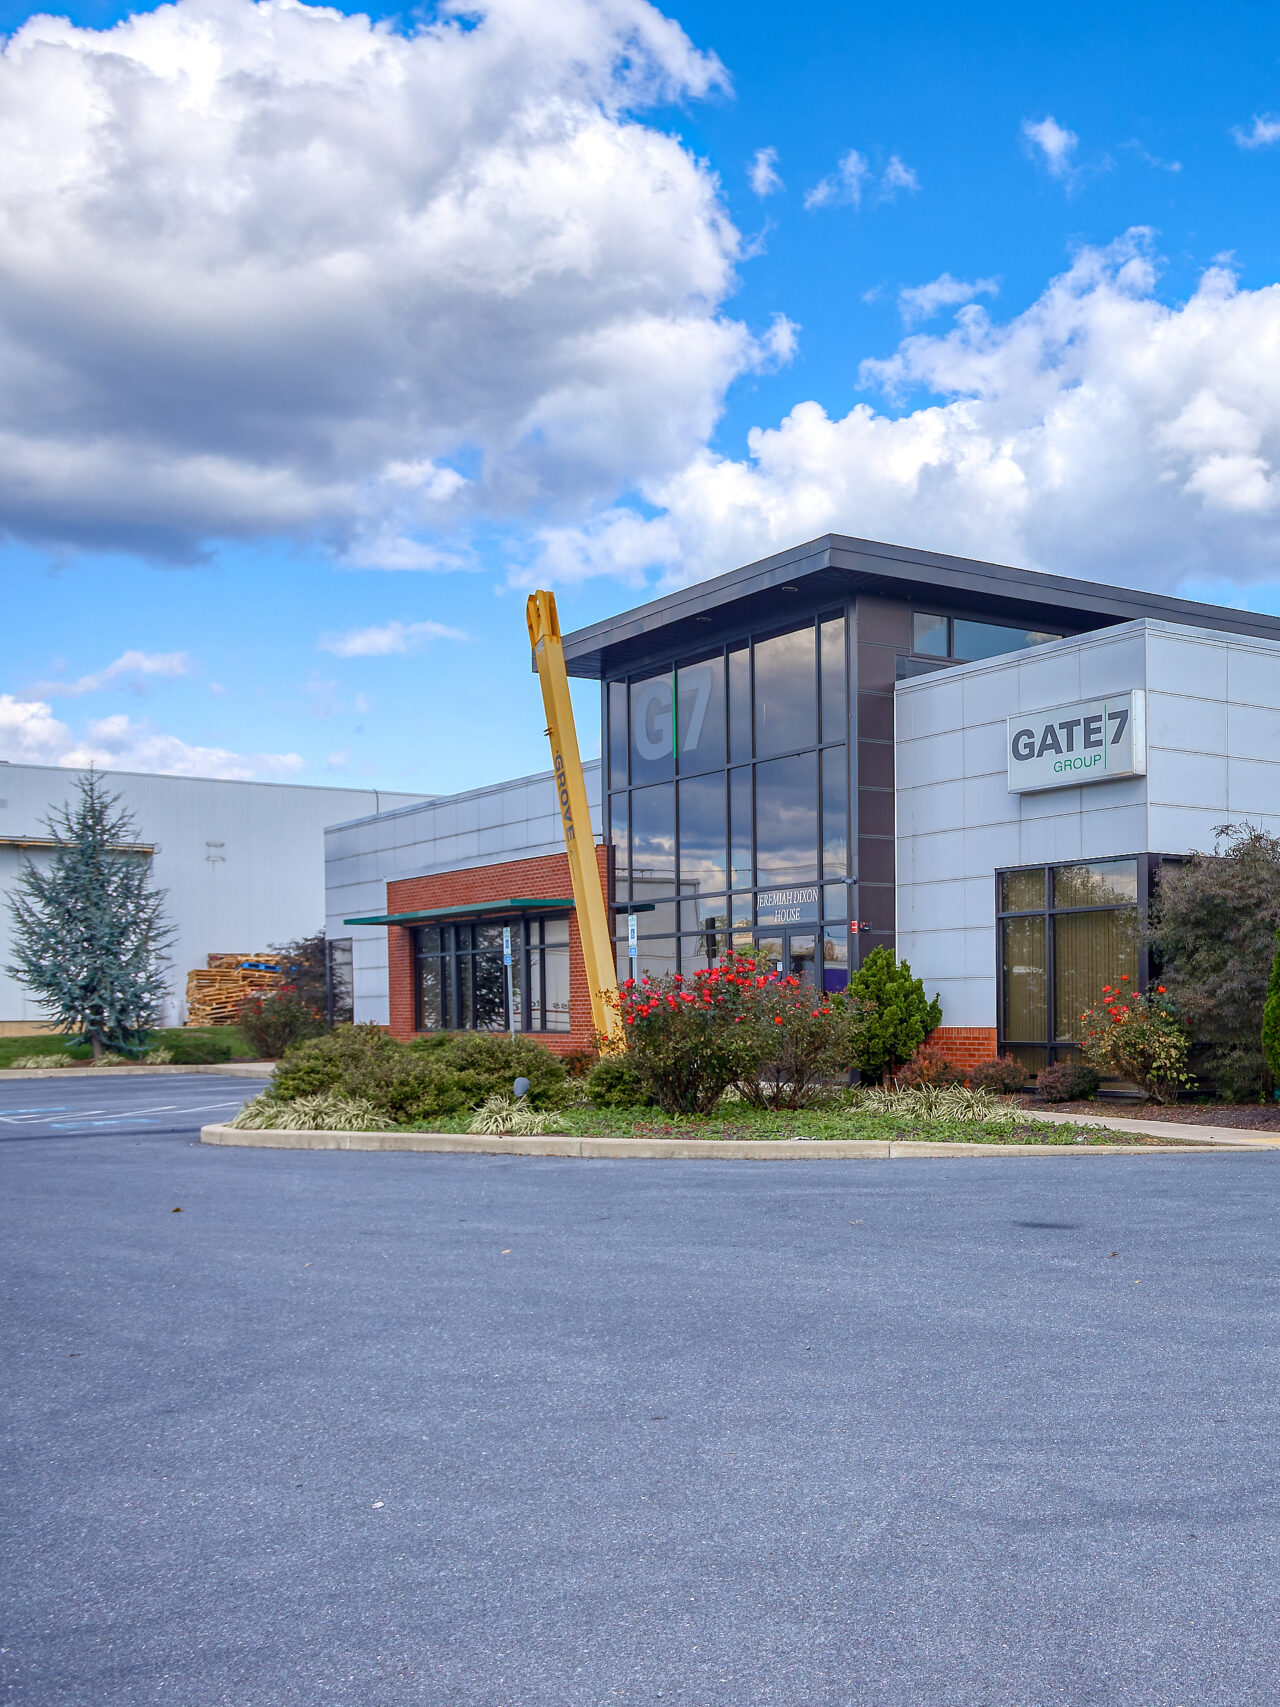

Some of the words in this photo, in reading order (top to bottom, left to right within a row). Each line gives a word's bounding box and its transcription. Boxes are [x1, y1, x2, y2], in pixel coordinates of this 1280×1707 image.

[1053, 754, 1102, 773] GROUP
[555, 754, 575, 842] GROVE
[756, 892, 793, 910] JEREMIAH
[793, 889, 818, 904] DIXON
[774, 908, 800, 922] HOUSE
